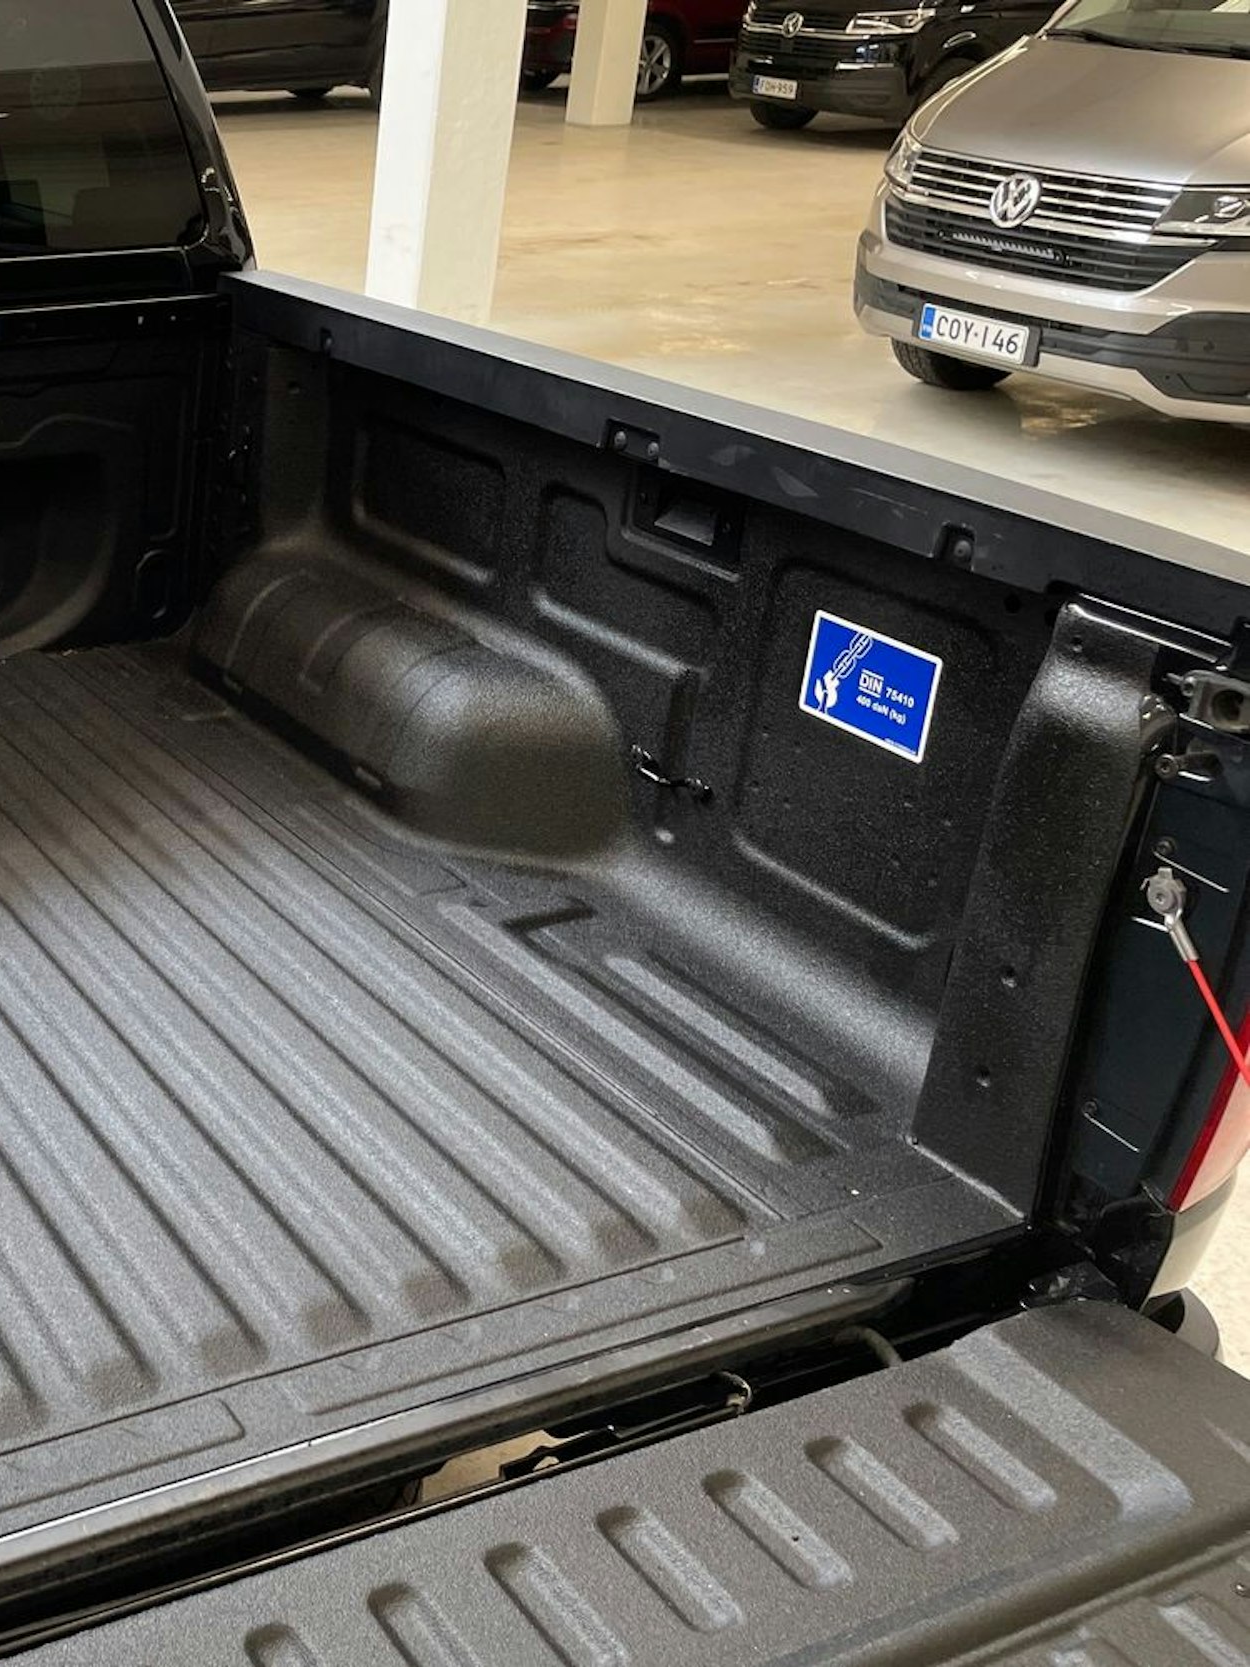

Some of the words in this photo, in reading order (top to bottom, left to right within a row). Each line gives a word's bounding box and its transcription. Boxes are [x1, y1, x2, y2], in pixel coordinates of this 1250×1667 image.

[936, 315, 1019, 354] COY-146
[859, 671, 883, 696] DIN
[886, 686, 914, 708] 75410
[889, 708, 907, 725] (kg)
